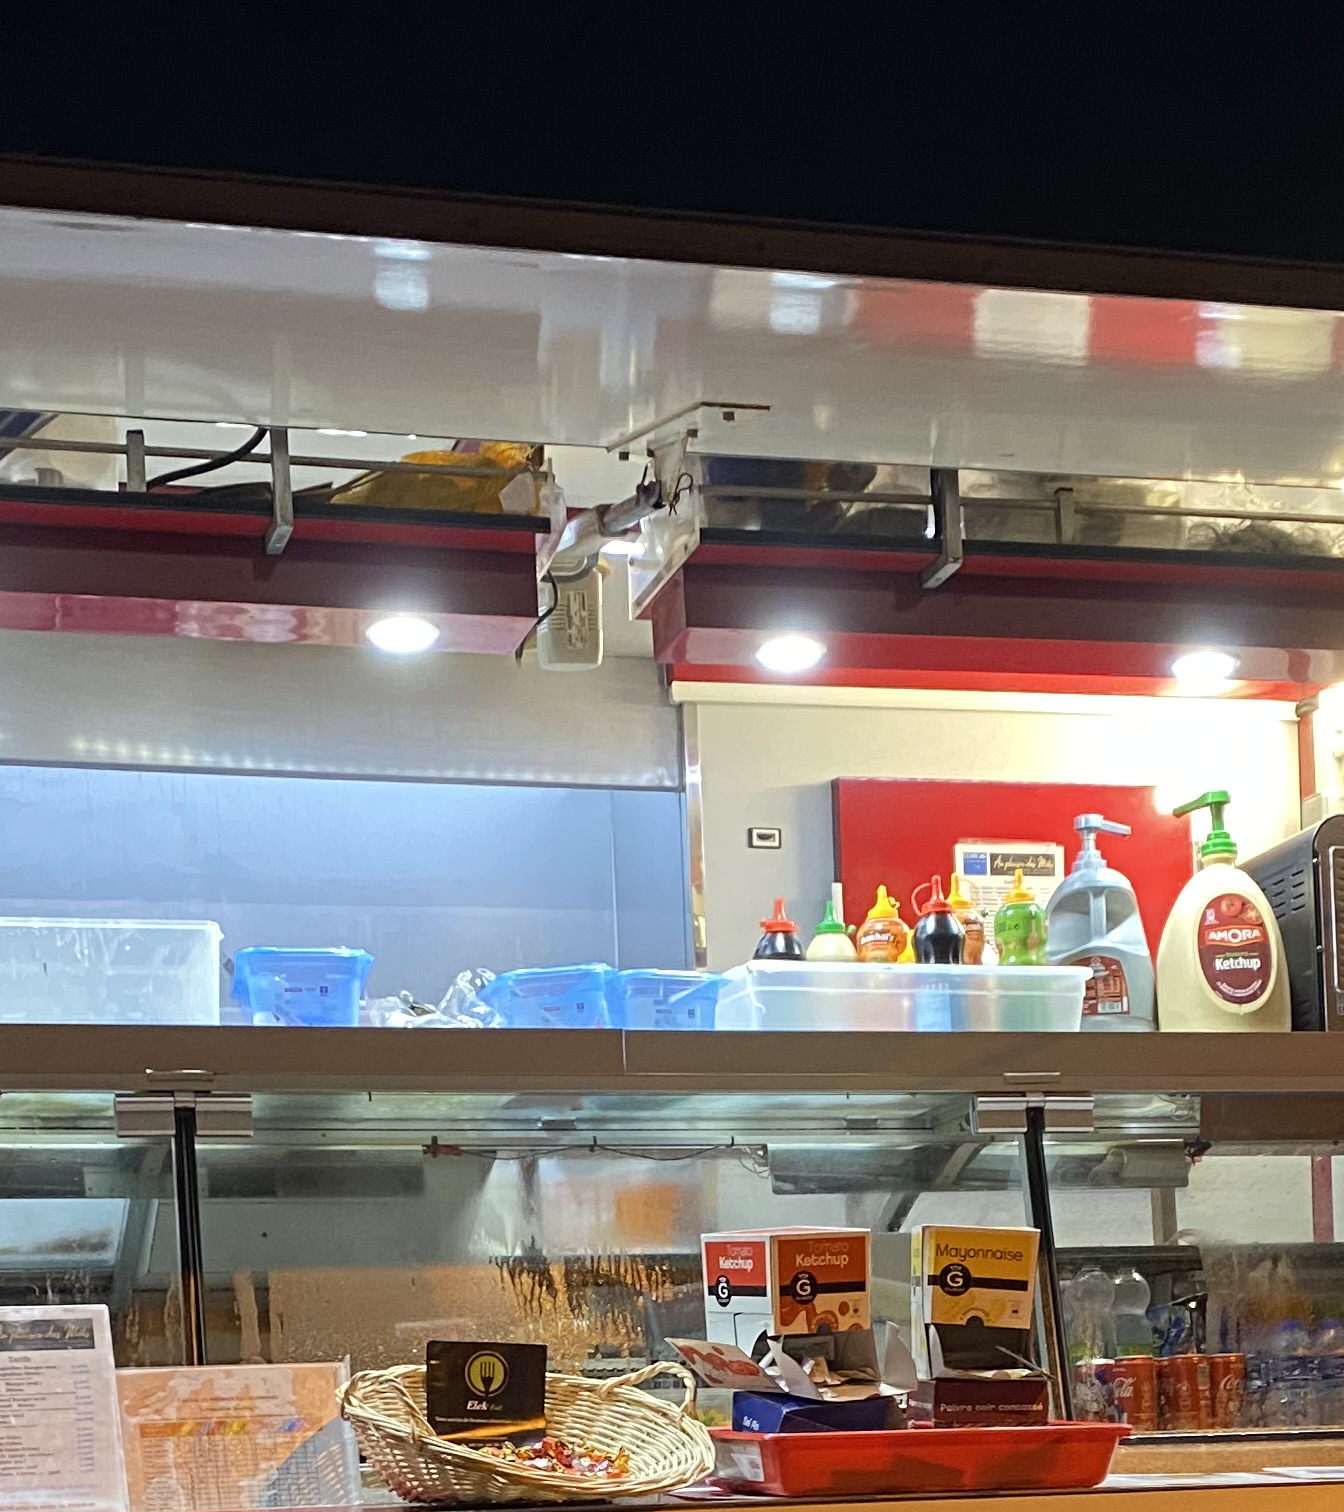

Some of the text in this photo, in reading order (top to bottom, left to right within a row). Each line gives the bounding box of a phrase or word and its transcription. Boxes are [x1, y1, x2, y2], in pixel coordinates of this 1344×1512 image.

[1208, 929, 1261, 943] AMORA
[1215, 957, 1261, 971] Ketchup
[795, 1252, 850, 1269] Ketchup
[936, 1243, 1023, 1262] Mayonnaise
[719, 1256, 754, 1272] Ketchup
[947, 1271, 964, 1287] G
[718, 1284, 729, 1299] G
[796, 1279, 811, 1296] G
